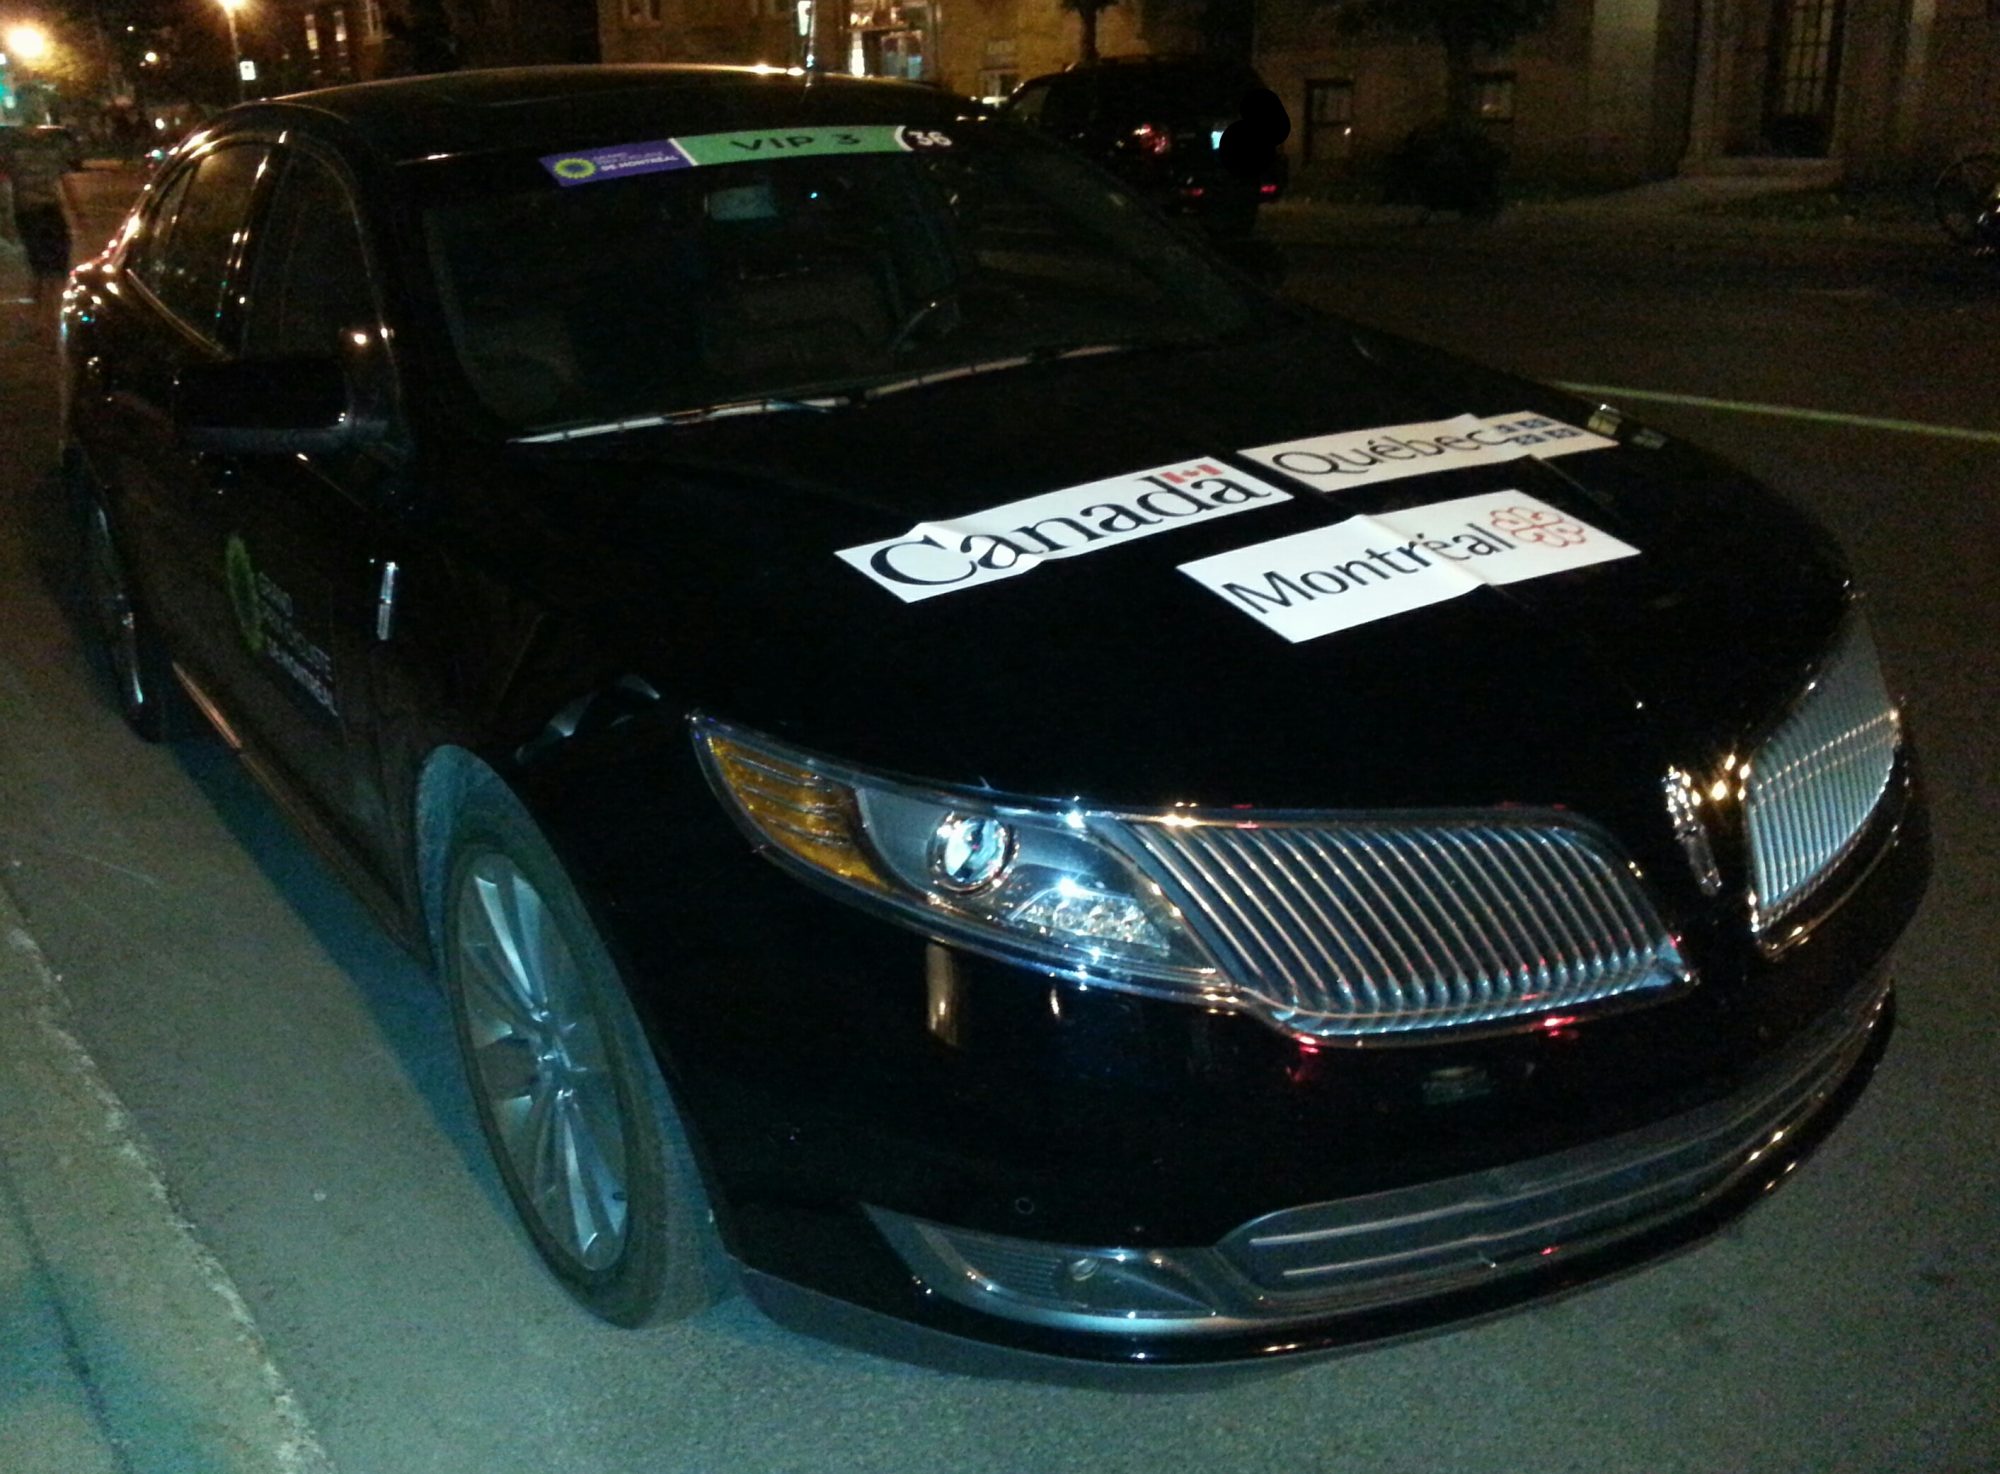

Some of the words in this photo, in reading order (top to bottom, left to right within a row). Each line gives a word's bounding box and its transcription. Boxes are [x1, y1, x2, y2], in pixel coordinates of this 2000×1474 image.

[730, 136, 815, 151] VIP
[832, 133, 861, 146] 3
[908, 131, 952, 147] 36
[1271, 429, 1511, 477] Québec
[870, 475, 1272, 586] Canada
[1222, 523, 1519, 614] Montréal
